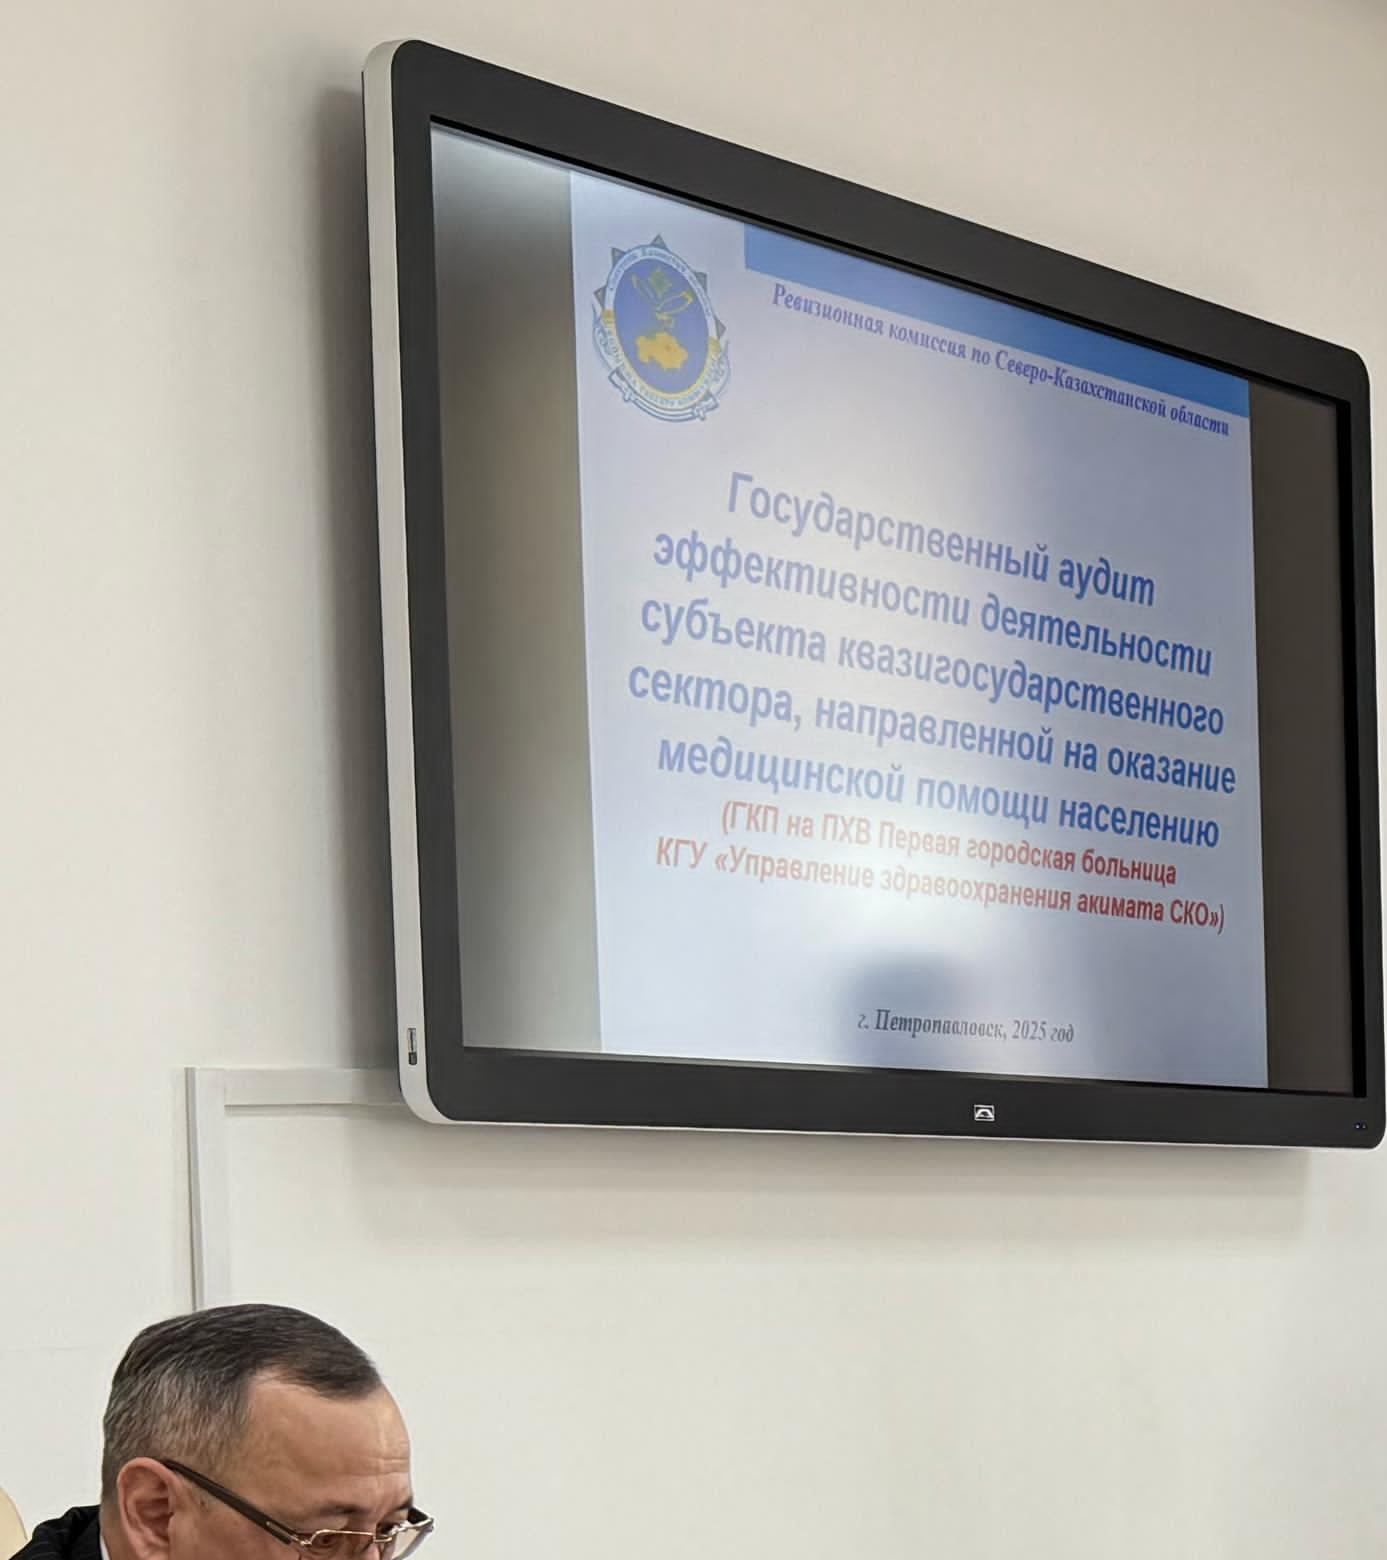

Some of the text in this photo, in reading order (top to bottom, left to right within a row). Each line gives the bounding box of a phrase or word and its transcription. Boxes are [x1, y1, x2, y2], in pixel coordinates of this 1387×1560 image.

[772, 283, 1230, 437] Ревизионная комиссия по Северо-Казахстанской области
[728, 471, 1155, 606] Государственный аудит
[641, 598, 1224, 735] субъекта квазигосударственного
[653, 530, 1212, 677] эффективности деятельности
[628, 665, 1236, 793] сектора, направленной на оказание
[658, 736, 1220, 847] медицинской помощи населению
[656, 837, 1225, 935] КГУ «Управление здравоохранения акимата СКО»)
[722, 800, 1176, 887] (ГКП на ПХВ Первая городская больница
[857, 1013, 869, 1029] г.
[1012, 1019, 1047, 1041] 2025
[1050, 1023, 1075, 1043] год
